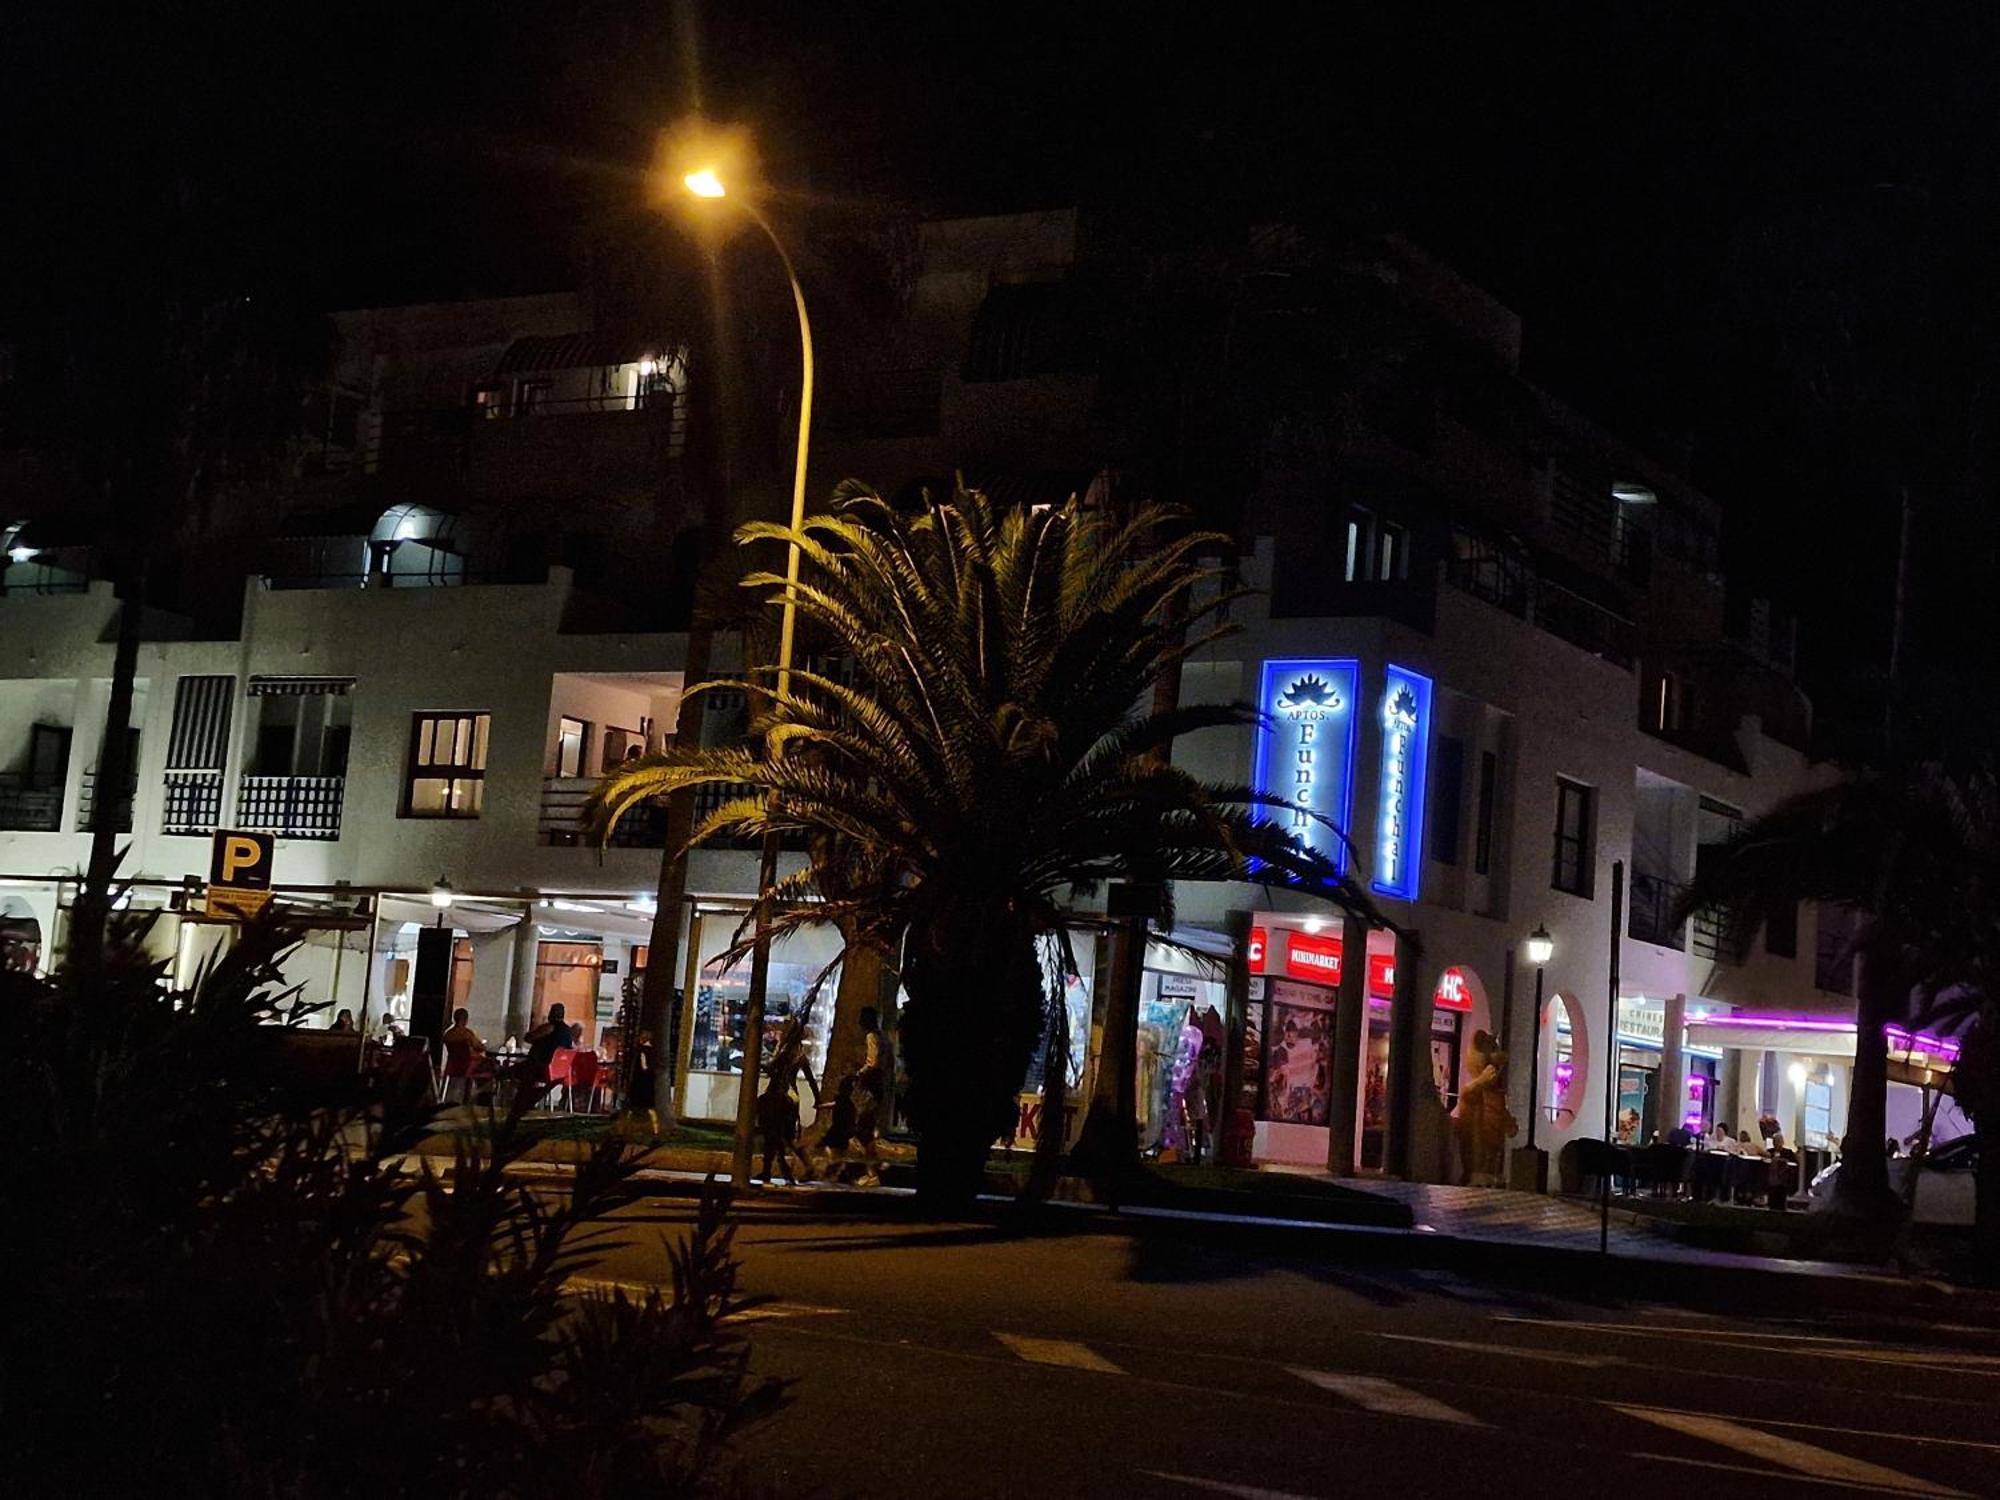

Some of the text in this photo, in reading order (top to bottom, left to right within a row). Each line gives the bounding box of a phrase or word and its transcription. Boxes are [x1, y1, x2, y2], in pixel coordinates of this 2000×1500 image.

[1293, 723, 1314, 857] Funch
[1391, 733, 1406, 881] Funchal
[222, 836, 261, 881] P
[1291, 949, 1340, 970] MINIMARKET
[1443, 974, 1464, 1002] HC
[1629, 1009, 1663, 1024] CHINES
